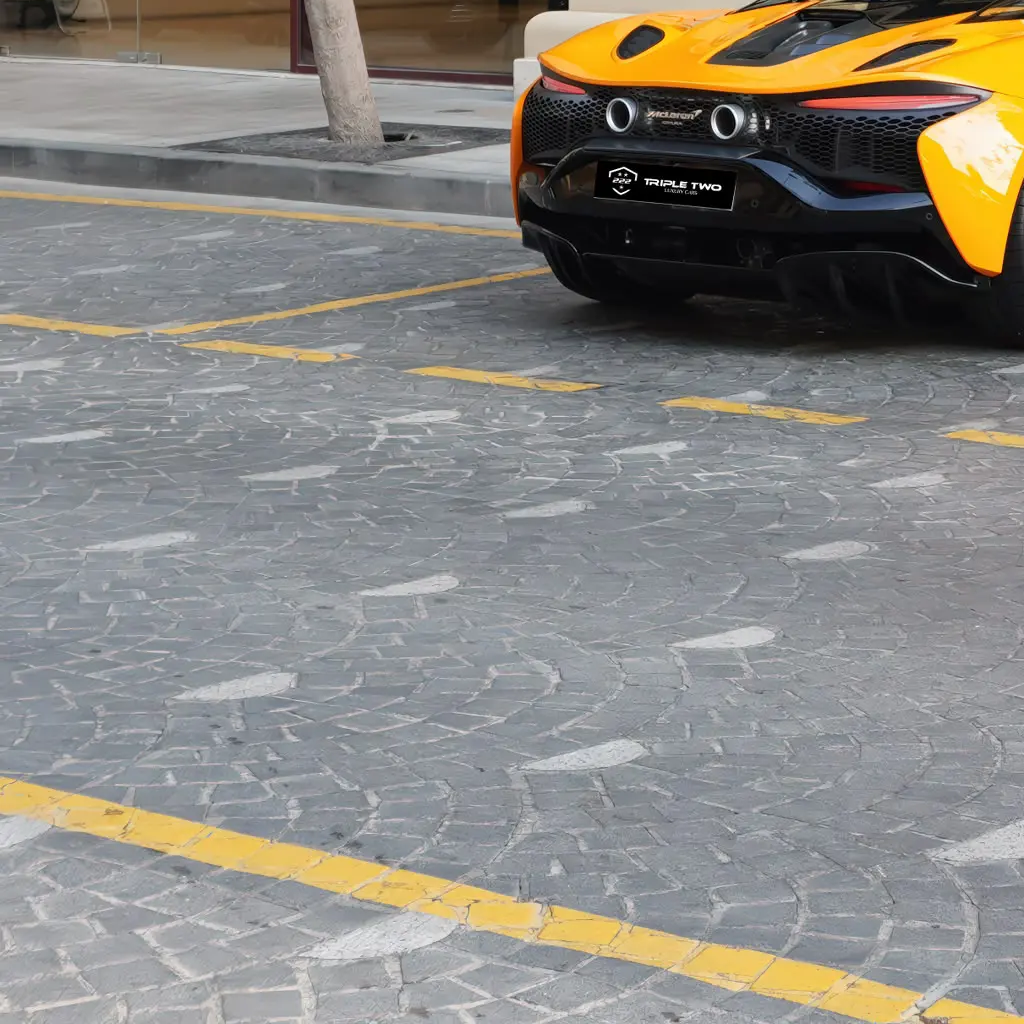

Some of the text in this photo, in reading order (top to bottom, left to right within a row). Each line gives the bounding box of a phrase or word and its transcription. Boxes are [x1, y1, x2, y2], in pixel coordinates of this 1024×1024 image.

[645, 110, 702, 120] McLaren
[612, 177, 632, 185] 222
[644, 177, 722, 192] TRIPLE TWO
